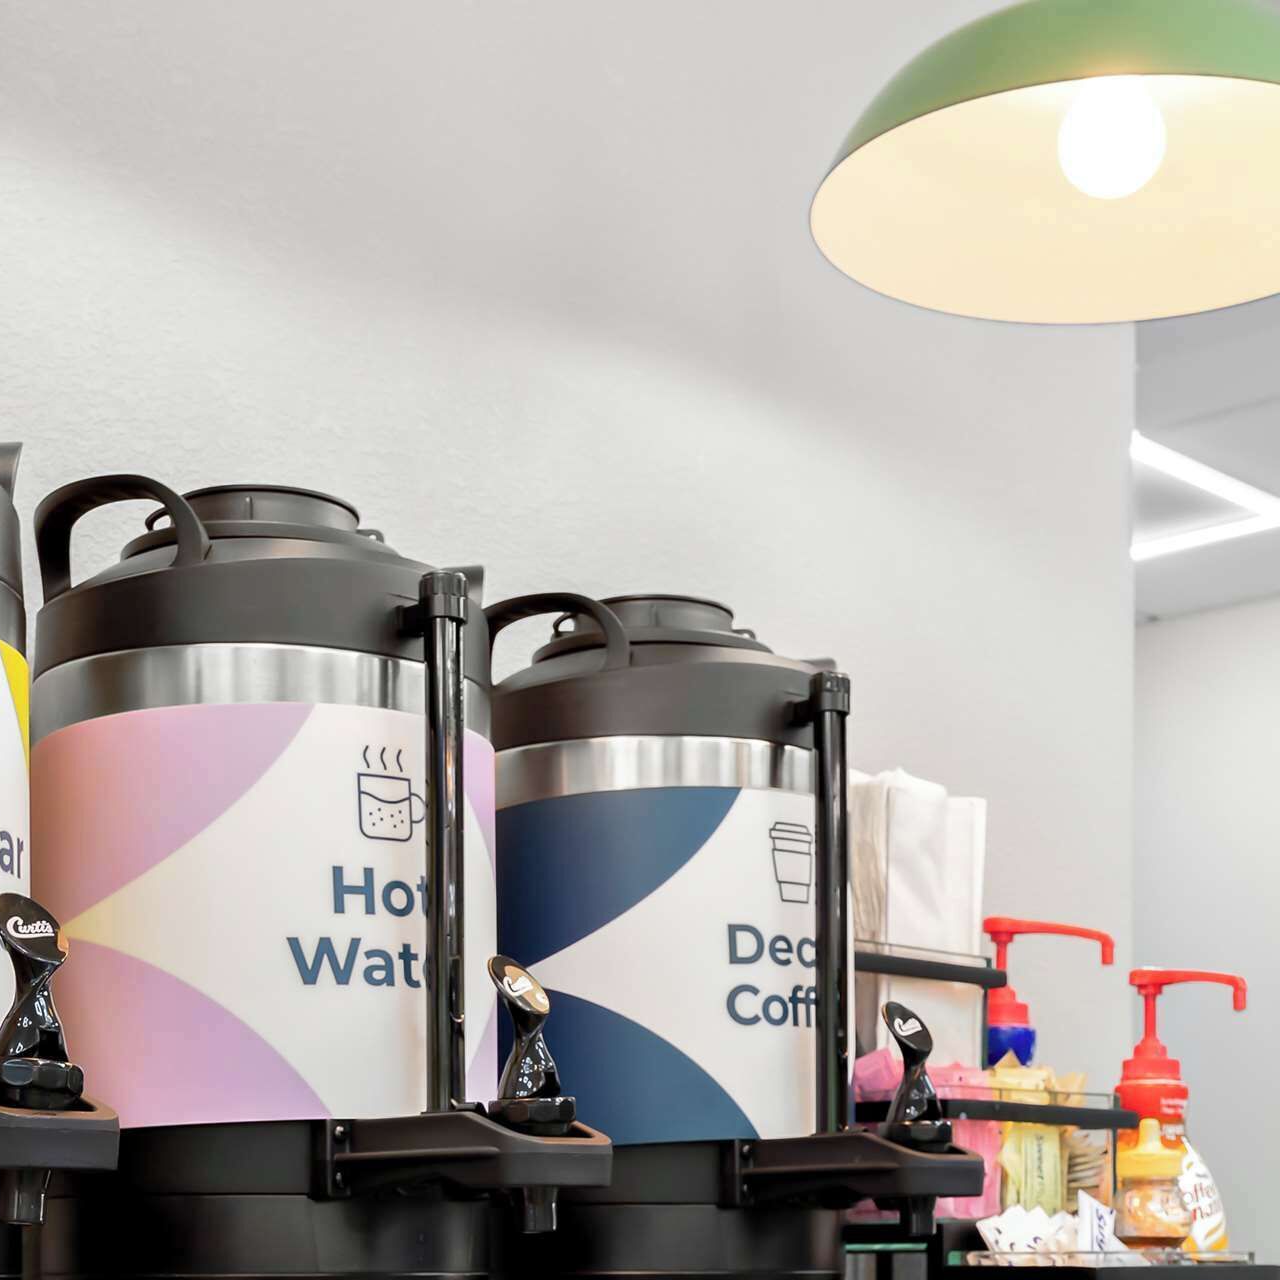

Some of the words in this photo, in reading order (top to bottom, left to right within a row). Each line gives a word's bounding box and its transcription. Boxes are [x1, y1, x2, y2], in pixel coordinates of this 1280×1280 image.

[332, 866, 429, 917] Hot
[6, 915, 55, 939] Curtis
[727, 923, 817, 968] Dec
[286, 936, 429, 989] Wat
[726, 984, 817, 1028] Coff
